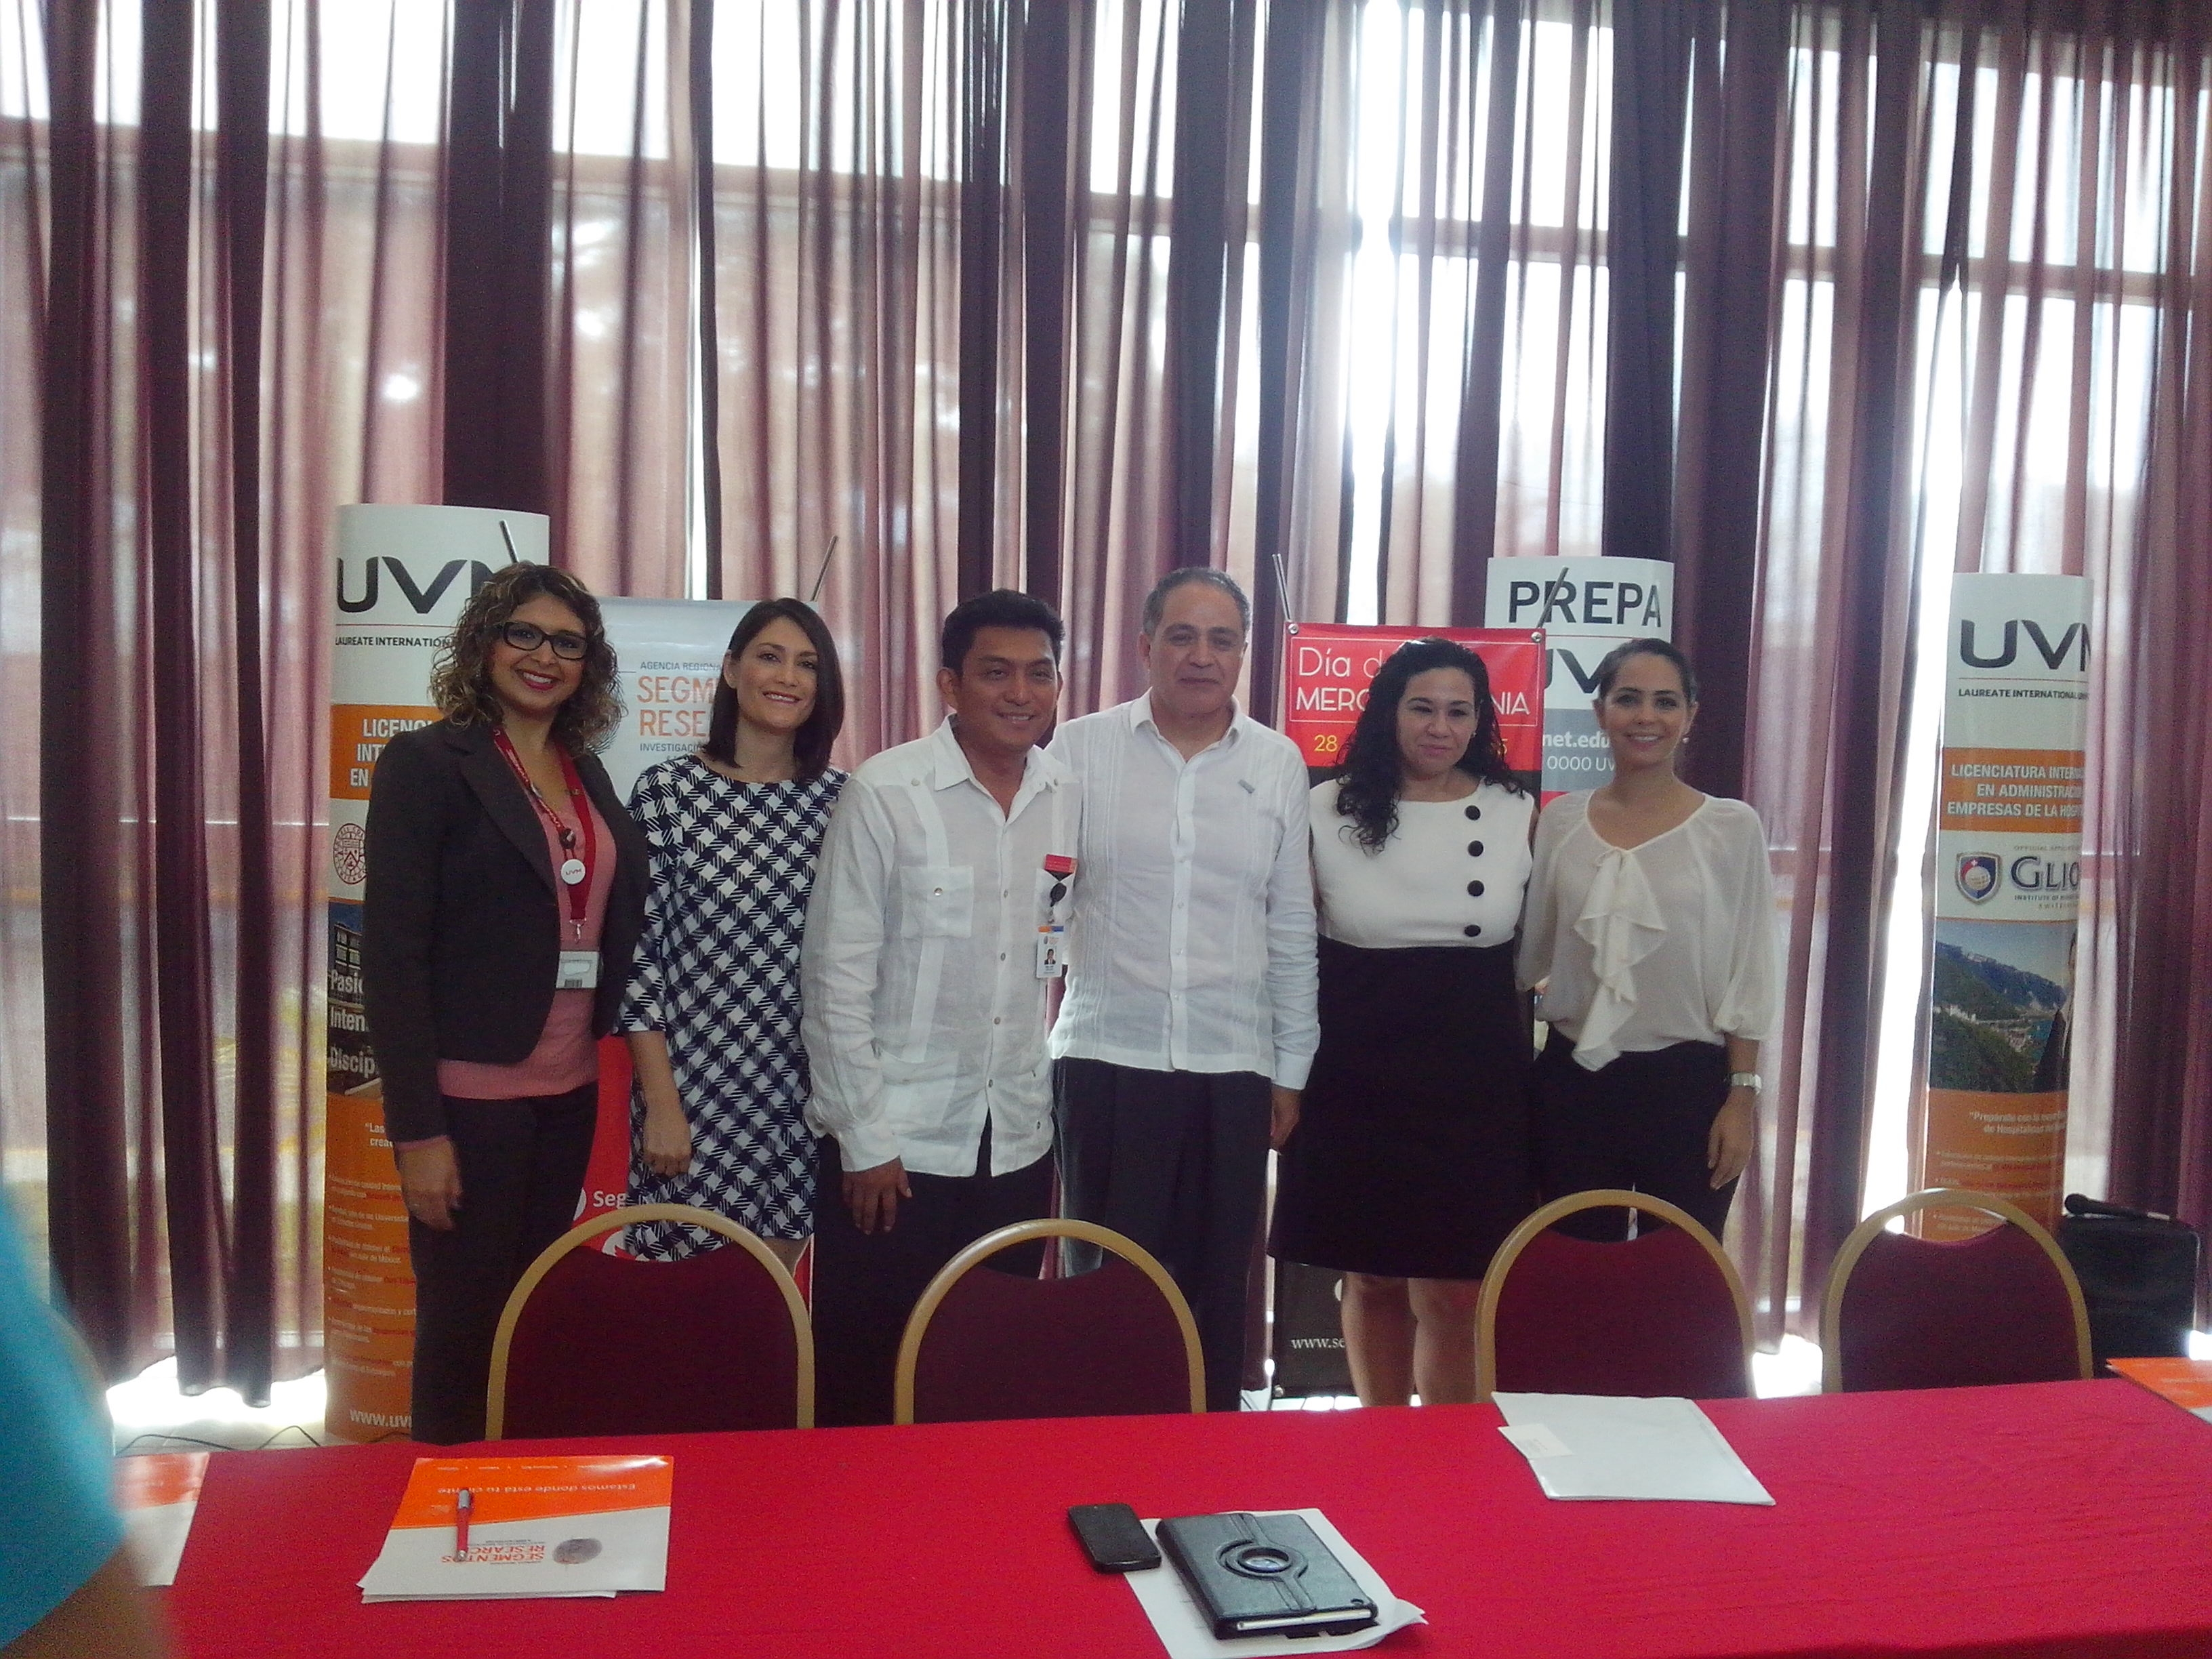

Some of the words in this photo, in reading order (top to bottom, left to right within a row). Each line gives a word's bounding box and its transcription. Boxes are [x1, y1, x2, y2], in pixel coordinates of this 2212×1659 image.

[1509, 581, 1662, 628] PREPA
[335, 636, 373, 646] LAUREATE
[375, 637, 451, 647] INTERNATION
[640, 661, 680, 670] AGENCIA
[683, 662, 721, 671] REGIONA
[1299, 646, 1351, 677] Día
[1364, 649, 1385, 678] d
[637, 676, 716, 703] SEGM
[1959, 689, 2011, 697] LAUREATE
[640, 710, 707, 737] RESE
[640, 743, 702, 752] INVESTIGACI
[1314, 735, 1338, 752] 28
[357, 743, 386, 762] INT
[1547, 756, 1591, 771] 0000
[1595, 756, 1616, 771] UV
[1952, 764, 2045, 778] LICENCIATURA
[350, 768, 369, 787] EN
[1977, 783, 1994, 797] EN
[1948, 802, 2021, 817] EMPRESAS
[2025, 804, 2041, 817] DE
[2044, 804, 2057, 817] LA
[2011, 855, 2079, 890] GLIO
[331, 969, 364, 994] Pasi
[330, 1006, 368, 1032] Inten
[330, 1046, 377, 1079] Discip
[592, 1190, 628, 1208] Seg
[1291, 1337, 1345, 1349] www.se
[535, 1485, 578, 1493] donde
[581, 1483, 636, 1492] Estamos
[468, 1545, 546, 1554] RESEARC
